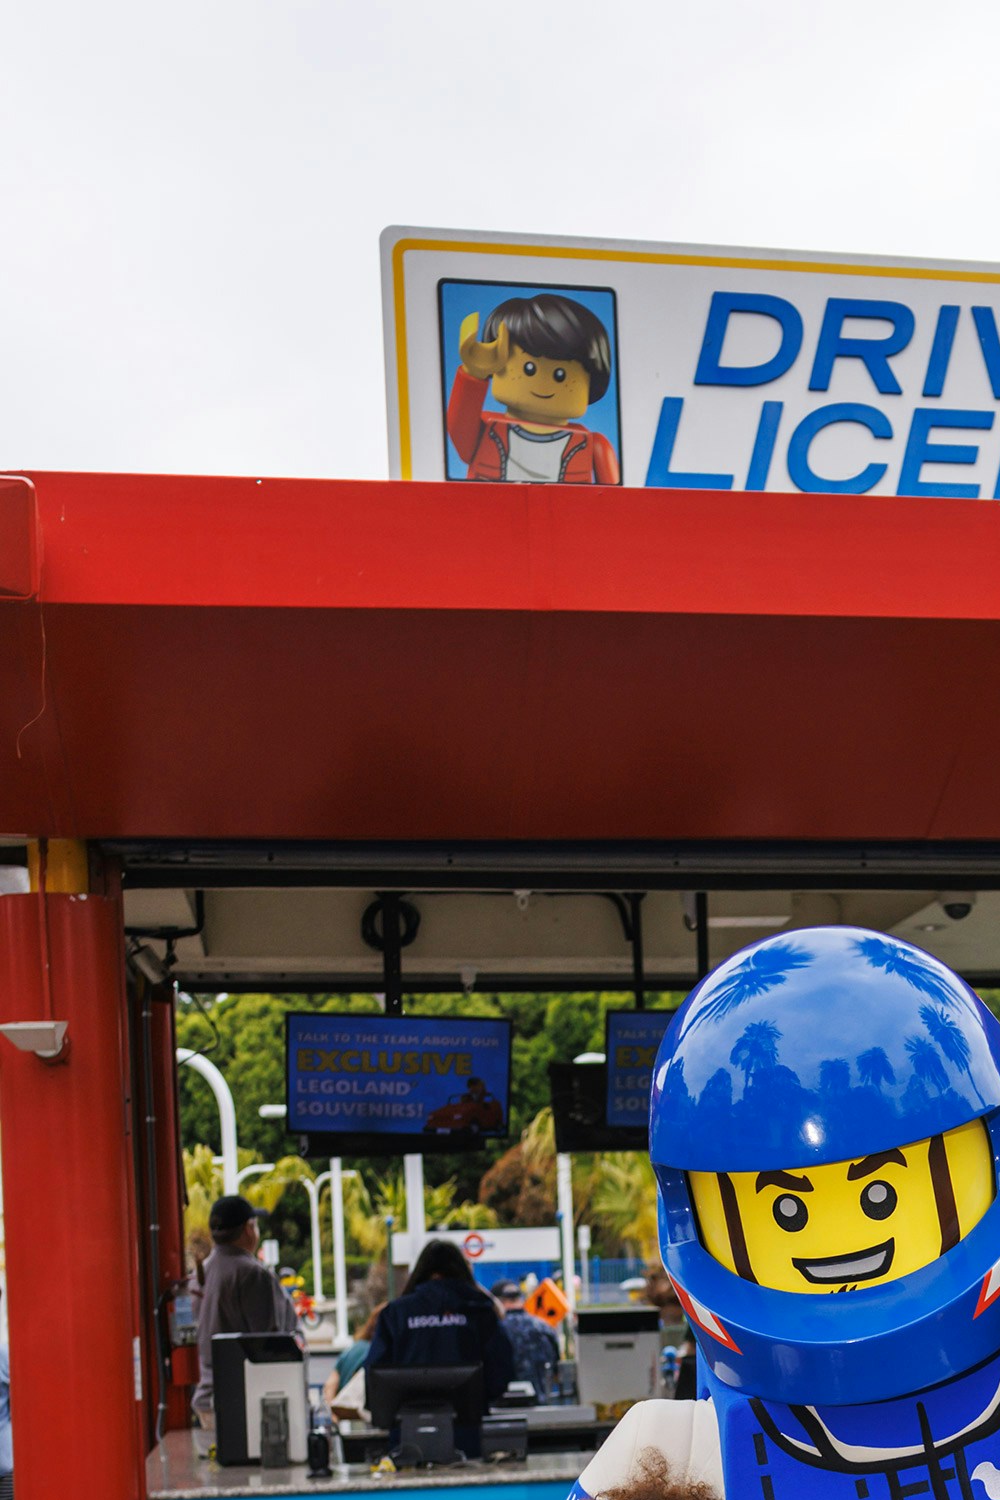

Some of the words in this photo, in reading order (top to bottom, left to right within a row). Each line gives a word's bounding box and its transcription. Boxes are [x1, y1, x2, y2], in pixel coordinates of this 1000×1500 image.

[298, 1032, 329, 1044] TALK
[334, 1033, 350, 1044] TO
[356, 1034, 379, 1044] THE
[384, 1035, 419, 1046] TEAM
[422, 1035, 467, 1046] ABOUT
[297, 1049, 473, 1076] EXCLUSIVE
[297, 1079, 411, 1096] LEGOLAND
[297, 1101, 424, 1118] SOUVENIRS!
